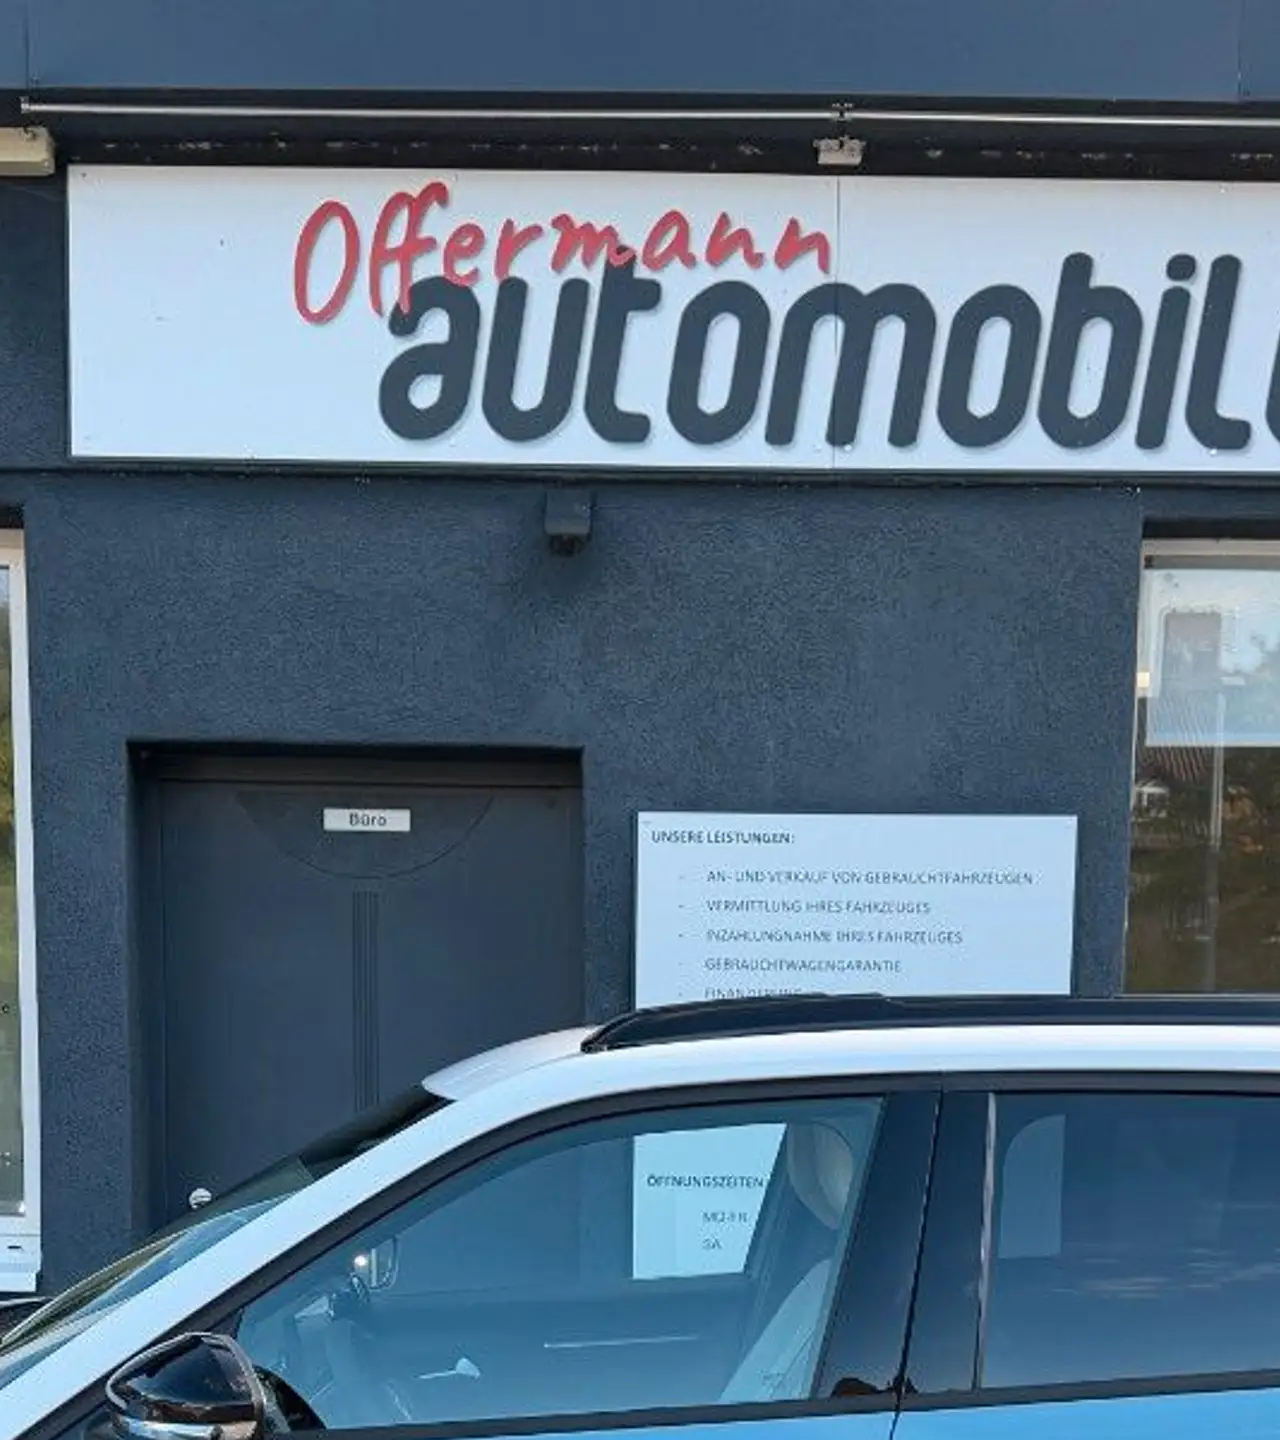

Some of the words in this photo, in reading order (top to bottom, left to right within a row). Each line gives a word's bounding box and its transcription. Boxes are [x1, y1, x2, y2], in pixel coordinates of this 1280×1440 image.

[293, 182, 832, 324] Offermann
[349, 812, 387, 826] Büro
[651, 831, 704, 842] UNSERE
[707, 832, 795, 844] LEISTUNGEN:
[706, 900, 802, 912] VERMITTLUNG
